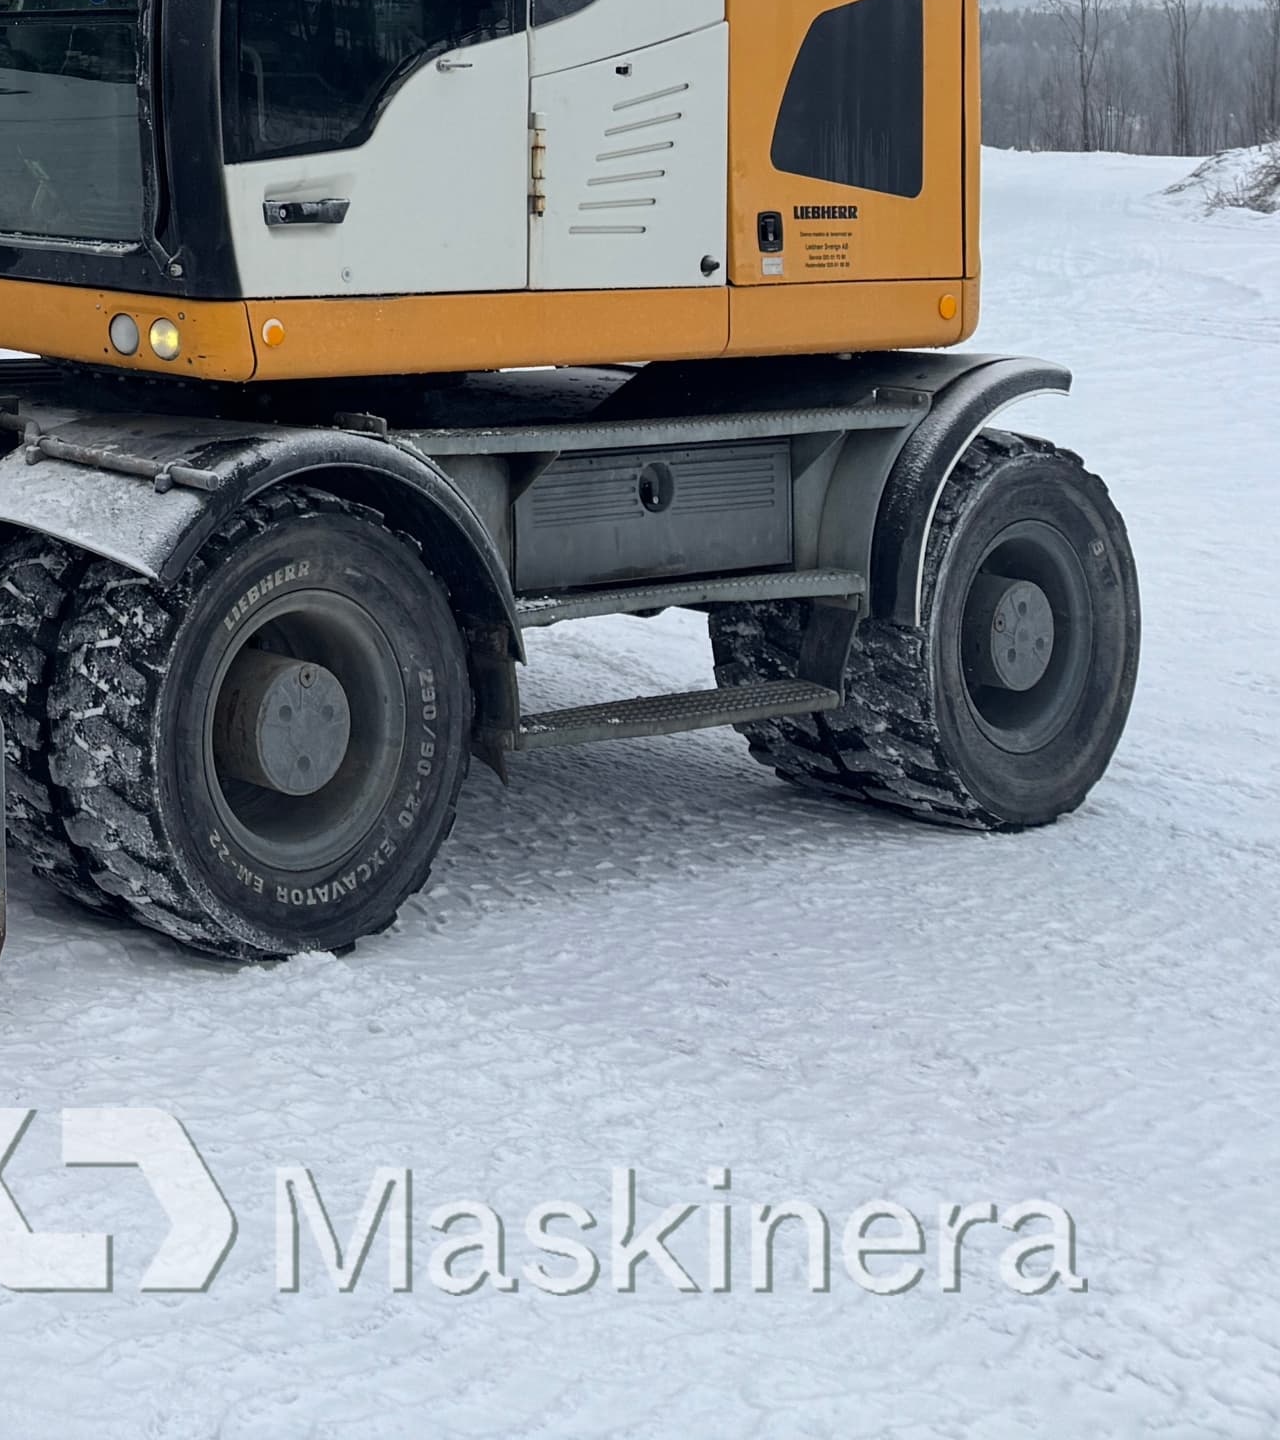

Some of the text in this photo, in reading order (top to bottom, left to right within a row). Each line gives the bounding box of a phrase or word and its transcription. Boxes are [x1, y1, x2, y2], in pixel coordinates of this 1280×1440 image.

[793, 205, 858, 220] LIEBHERR
[223, 560, 310, 631] LIEBHERR
[398, 668, 437, 828] 290/90-20
[276, 837, 397, 905] EXCAVATOR
